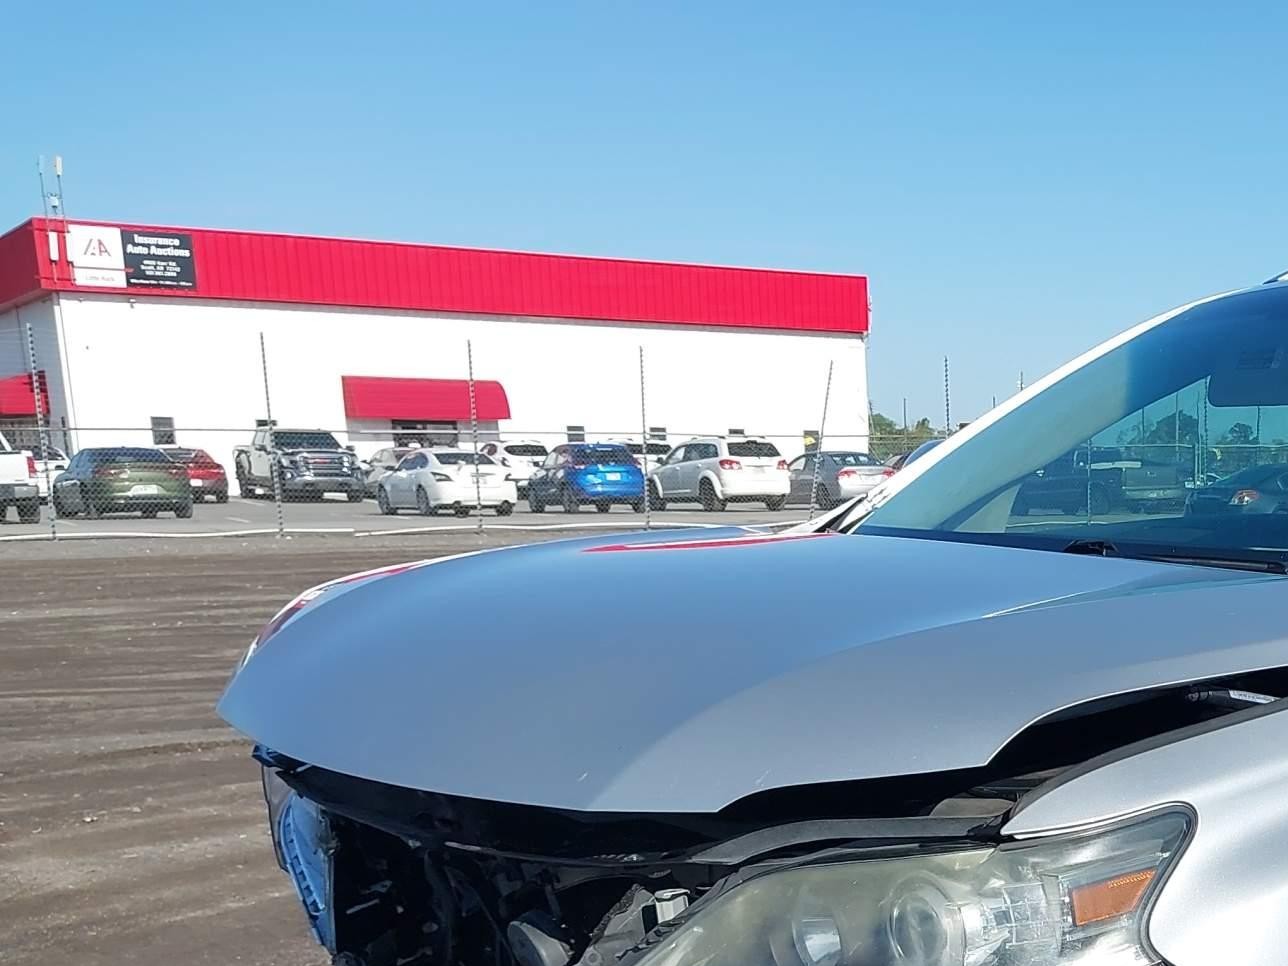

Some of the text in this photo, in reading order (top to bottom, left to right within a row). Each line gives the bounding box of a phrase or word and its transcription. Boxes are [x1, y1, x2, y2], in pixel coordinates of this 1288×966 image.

[133, 234, 180, 246] Insurance
[126, 243, 191, 258] Auto Auctions
